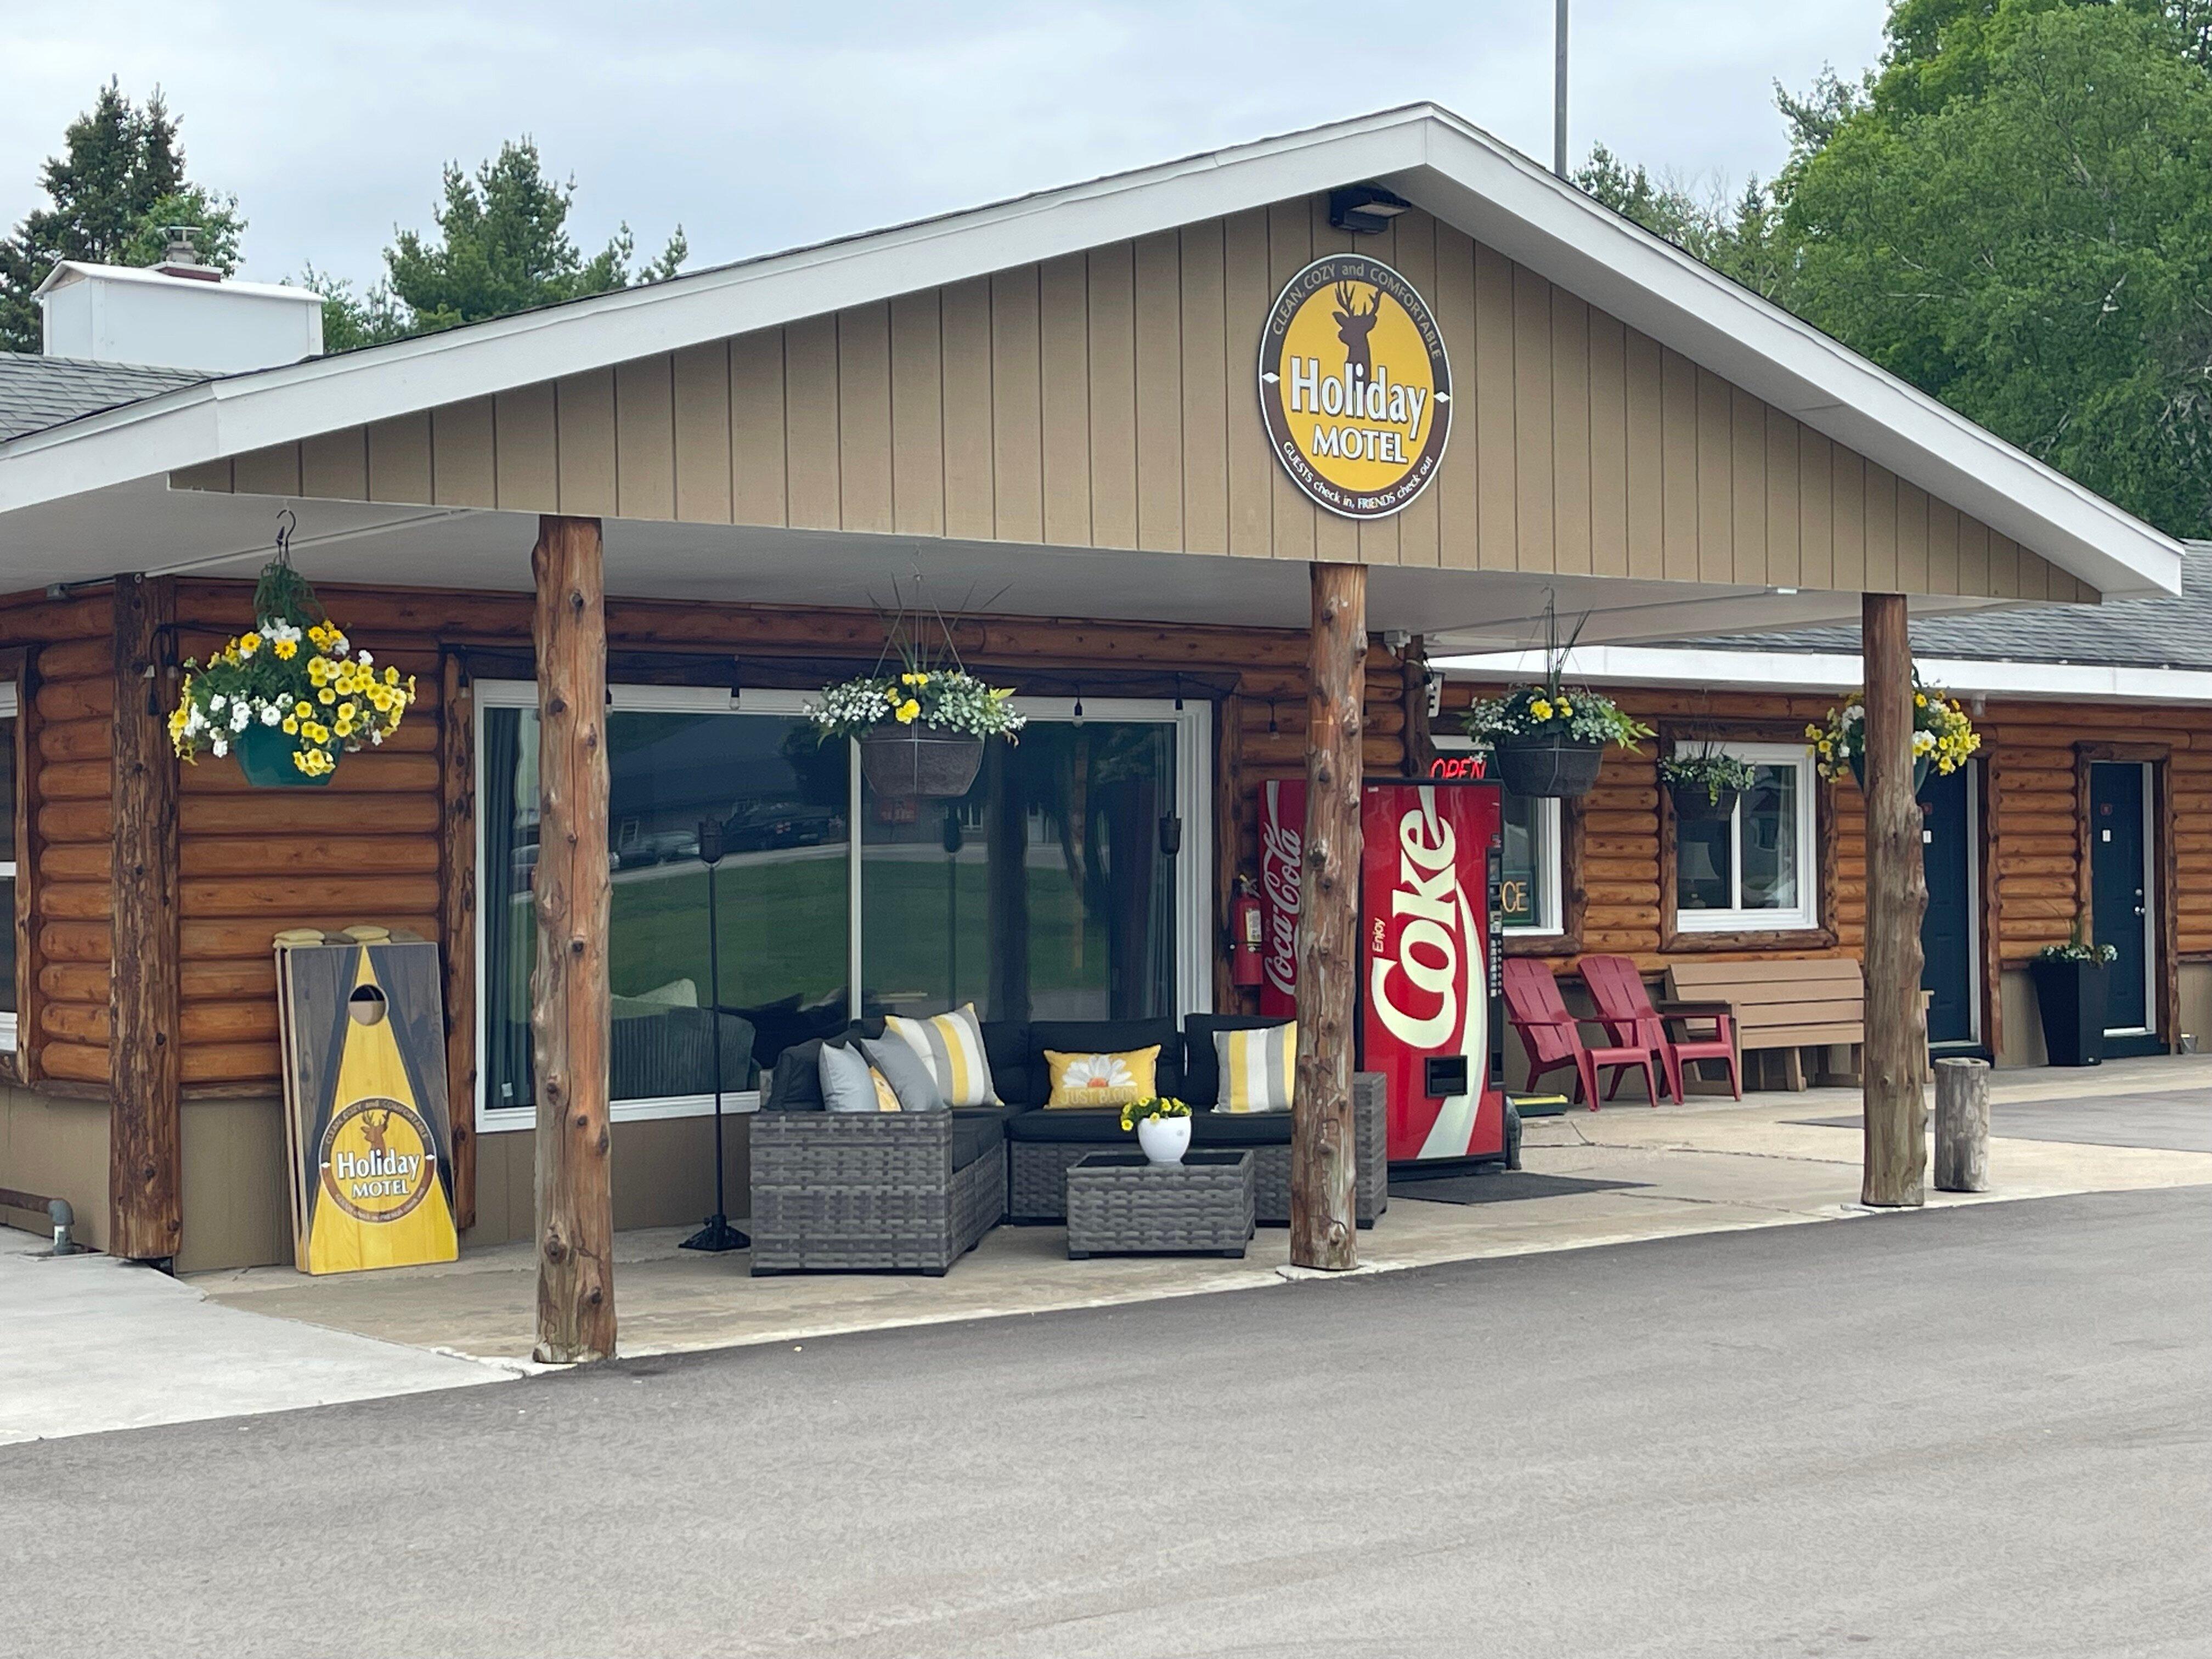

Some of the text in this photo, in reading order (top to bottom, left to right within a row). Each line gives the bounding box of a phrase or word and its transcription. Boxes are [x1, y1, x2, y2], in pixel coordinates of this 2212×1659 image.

[1273, 263, 1442, 360] CLEAN, COZY and COMFORTABLE
[1290, 356, 1426, 440] Holiday
[1312, 425, 1408, 464] MOTEL
[1283, 441, 1314, 483] GUESTS
[1313, 481, 1340, 504] check
[1357, 492, 1396, 509] FRIENDS
[1397, 474, 1421, 499] check
[1420, 455, 1434, 475] out
[1429, 757, 1487, 780] OPEN
[1263, 821, 1301, 995] Coca-Cola
[1372, 809, 1457, 1049] Coke
[1372, 917, 1386, 952] Enjoy
[1061, 1088, 1094, 1105] JUST
[337, 1149, 421, 1182] Holiday
[352, 1179, 411, 1199] MOTEL
